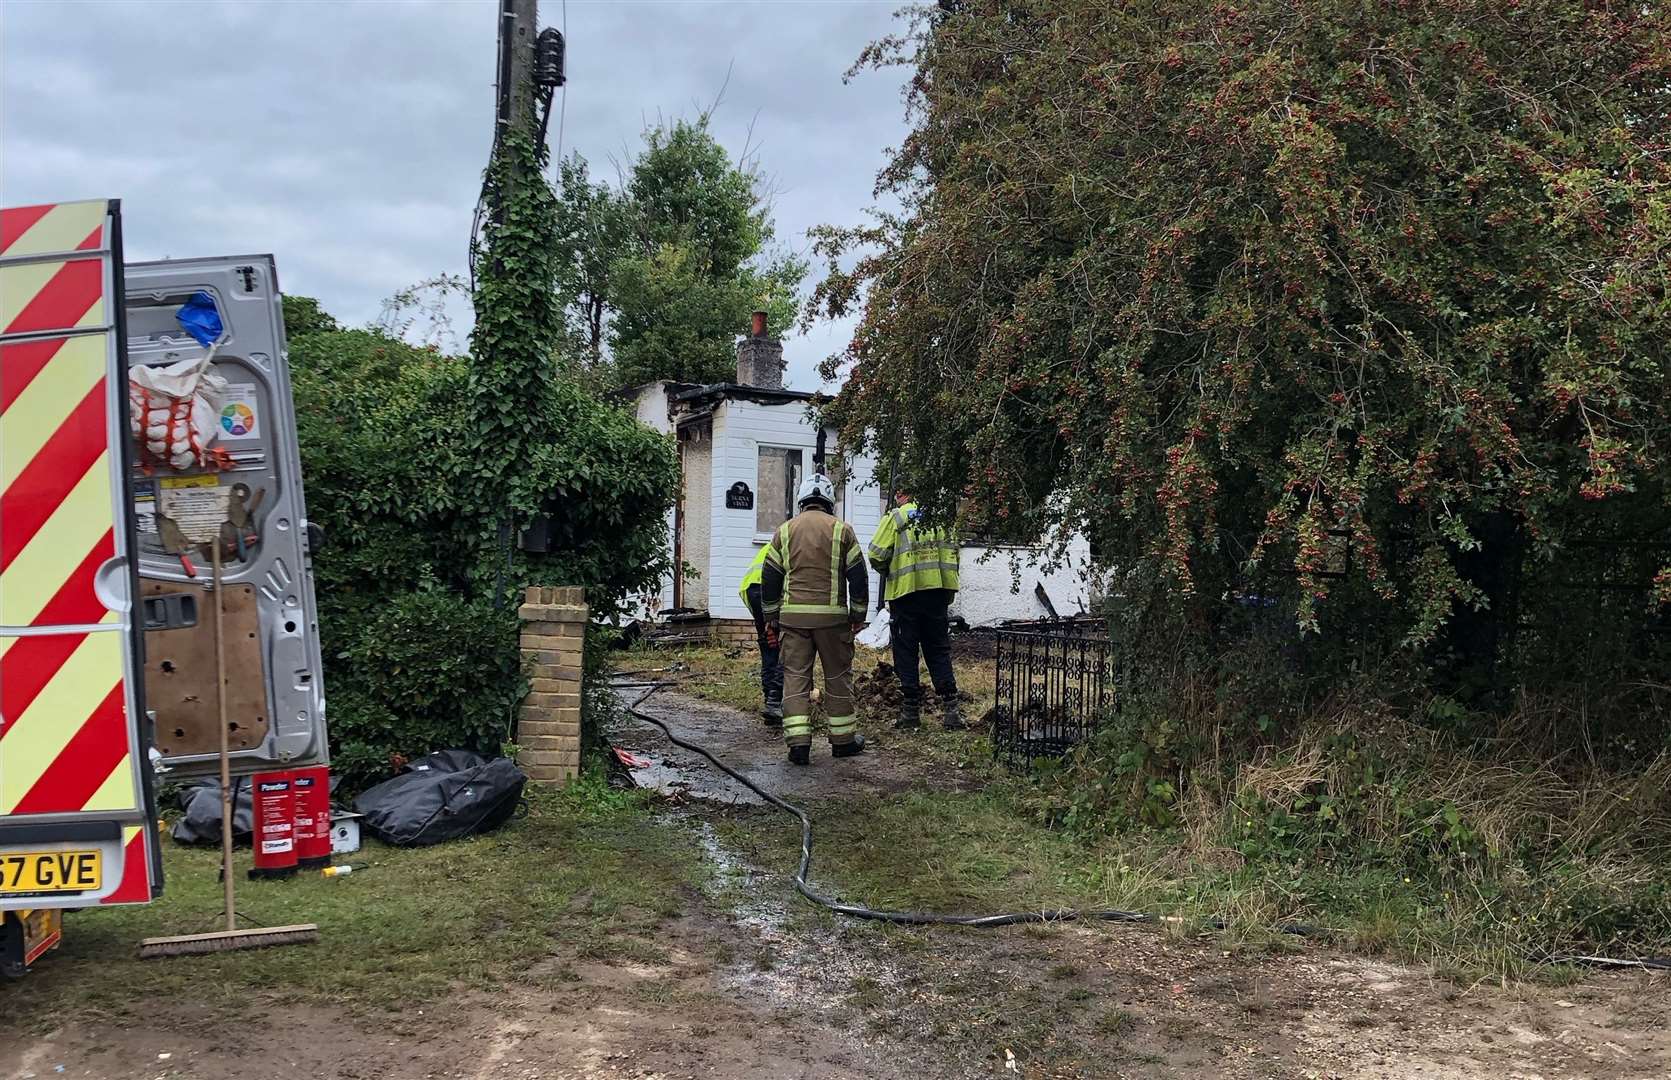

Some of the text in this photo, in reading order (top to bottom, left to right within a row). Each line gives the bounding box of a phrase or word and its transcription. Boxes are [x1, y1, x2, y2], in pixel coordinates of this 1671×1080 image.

[261, 783, 288, 792] Powder
[0, 854, 96, 887] 7 GVE
